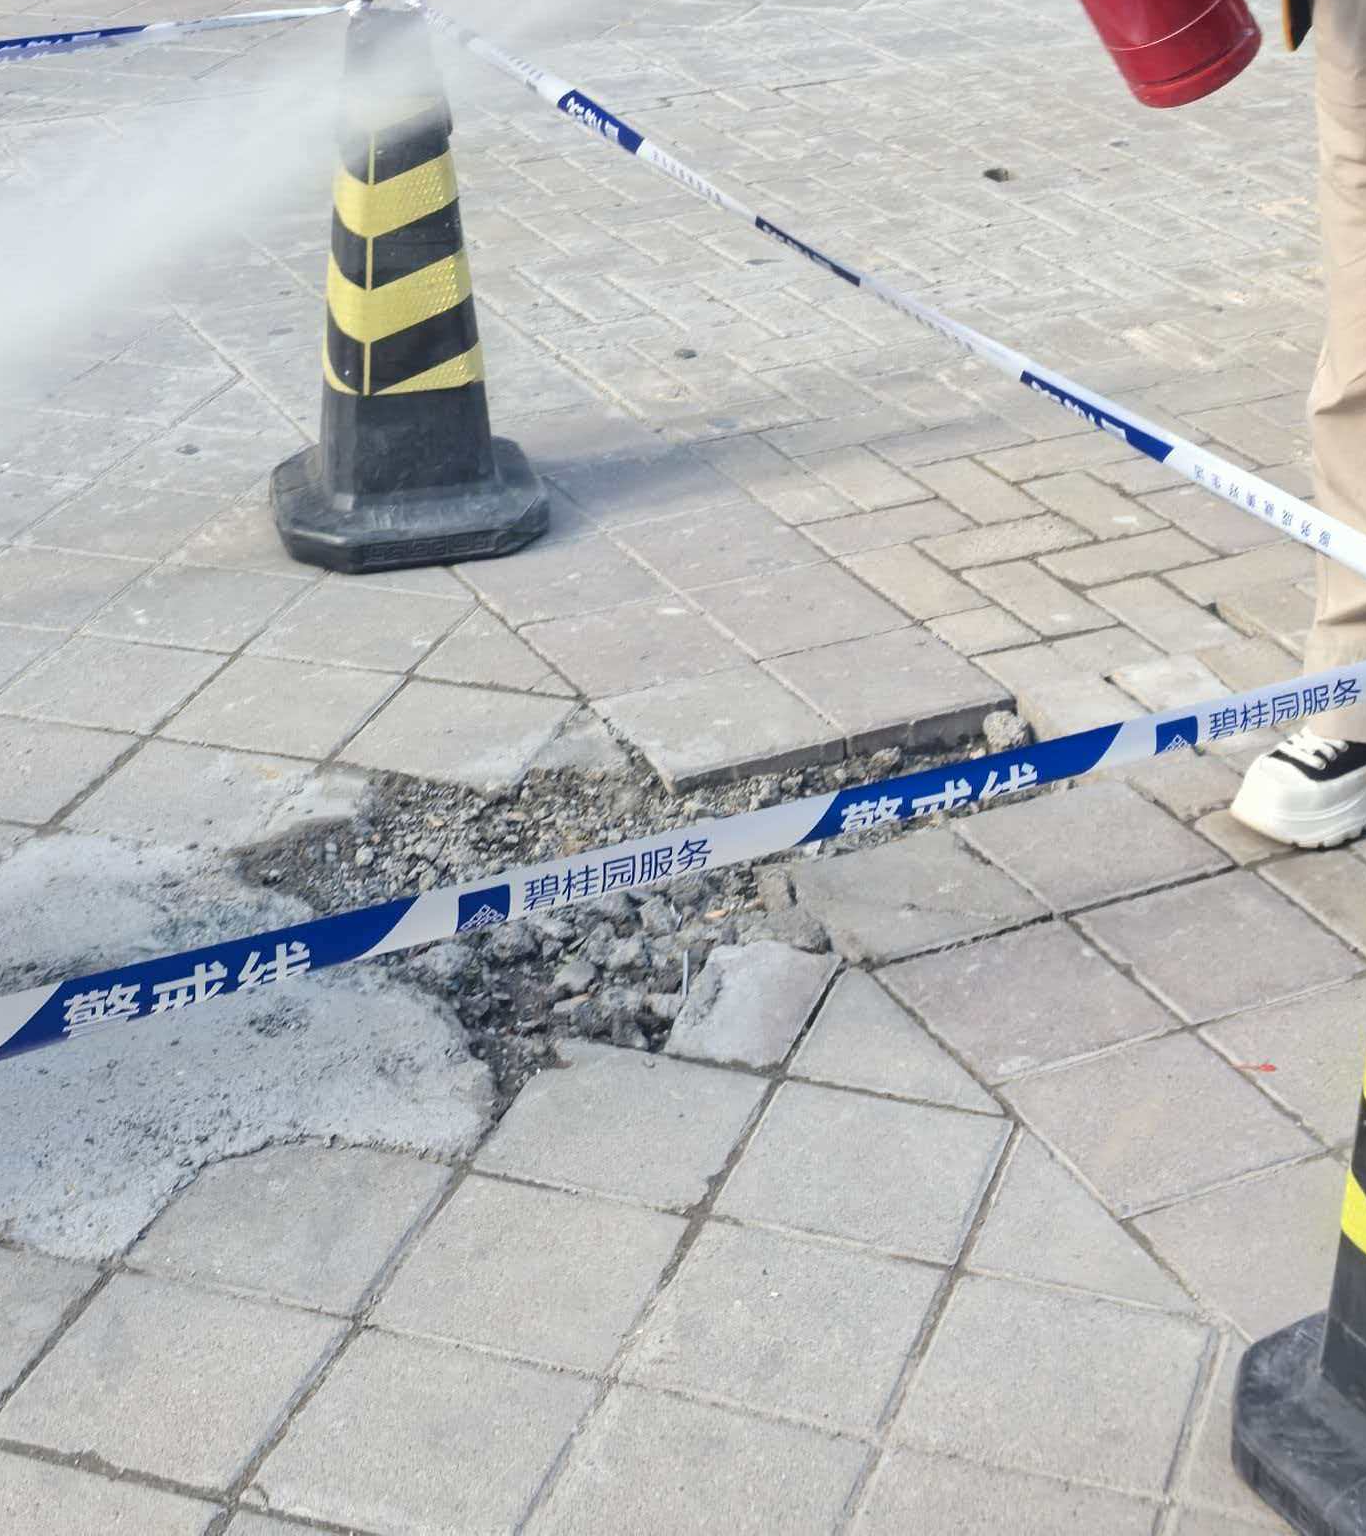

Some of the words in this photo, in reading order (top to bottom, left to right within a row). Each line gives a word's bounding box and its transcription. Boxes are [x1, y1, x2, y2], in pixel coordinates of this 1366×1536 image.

[1209, 677, 1362, 743] 碧桂园服务
[523, 838, 713, 912] 碧桂园服务
